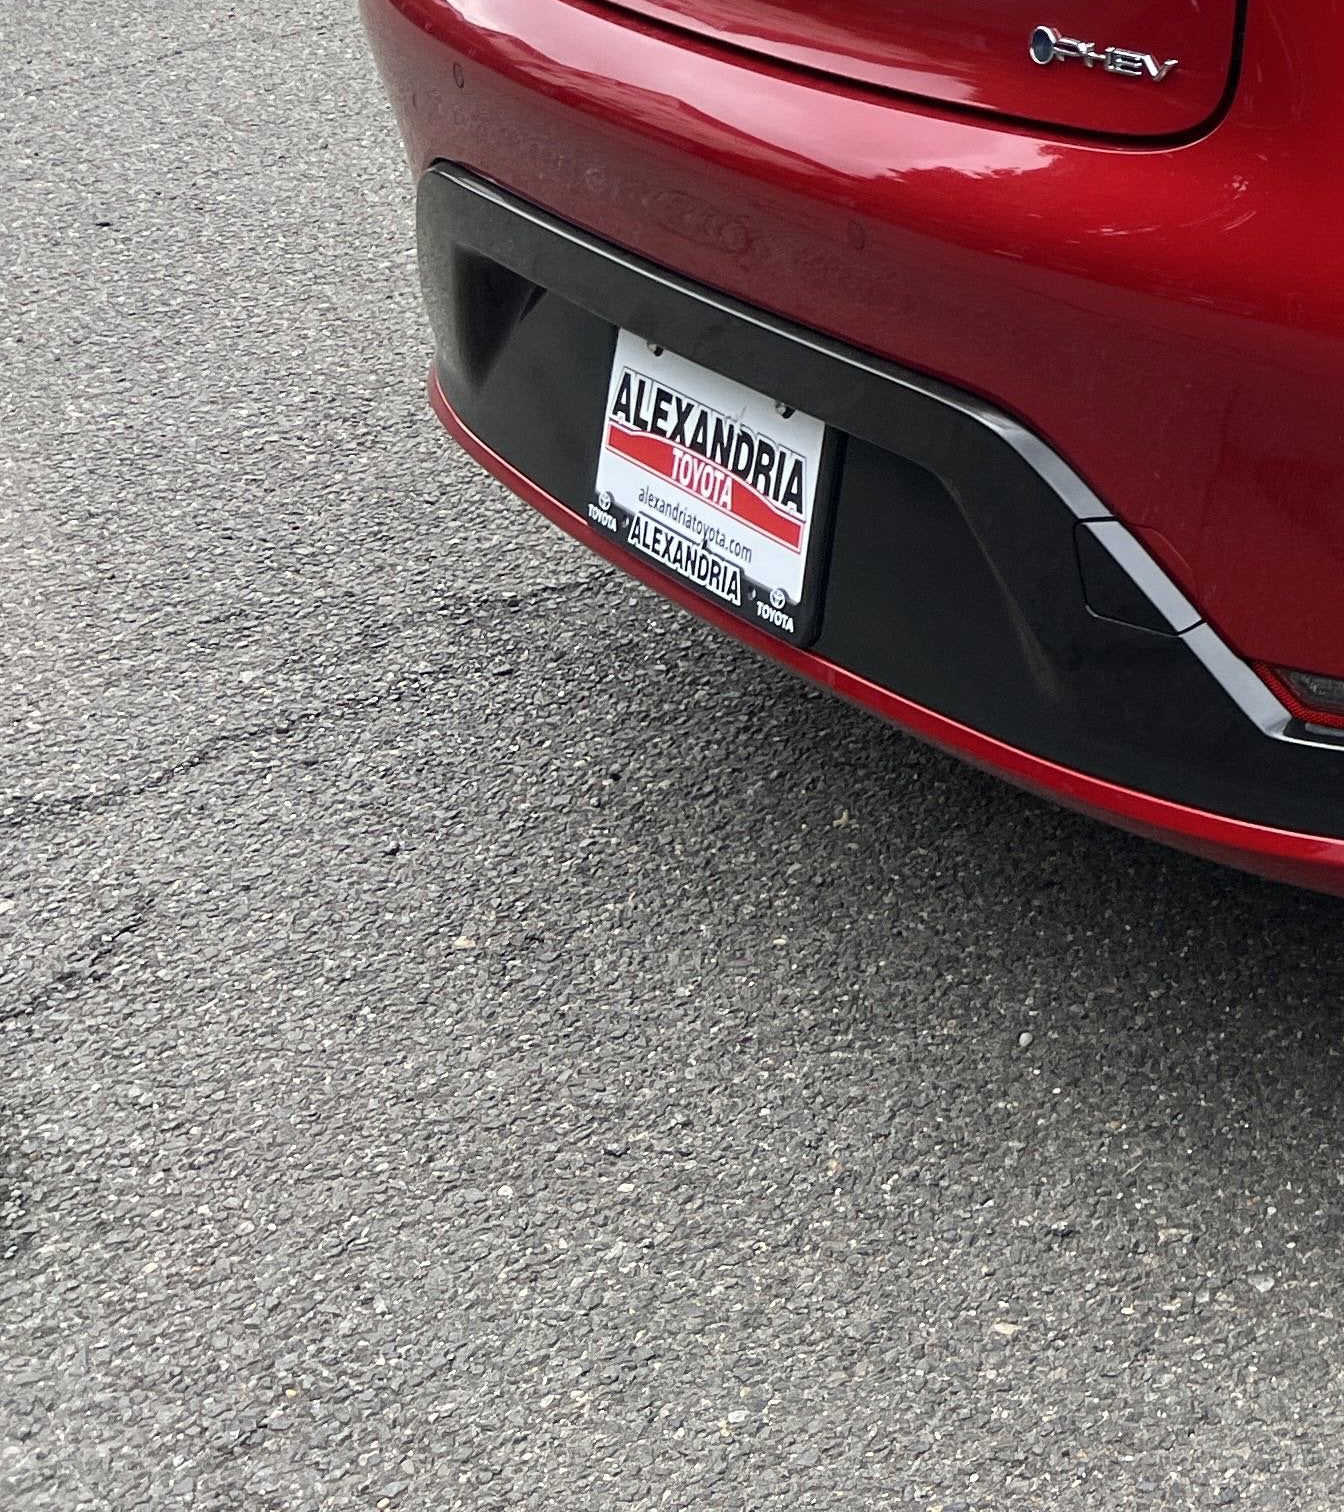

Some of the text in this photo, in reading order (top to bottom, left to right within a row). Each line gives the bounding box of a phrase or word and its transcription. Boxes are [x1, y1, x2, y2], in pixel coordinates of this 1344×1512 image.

[612, 372, 804, 515] ALEXANDRIA
[672, 448, 733, 511] TOYOTA
[588, 503, 617, 533] TOYOTA
[638, 485, 753, 564] alexandriatoyota.com
[629, 515, 741, 606] ALEXANDRIA
[757, 601, 795, 633] TOYOTA
